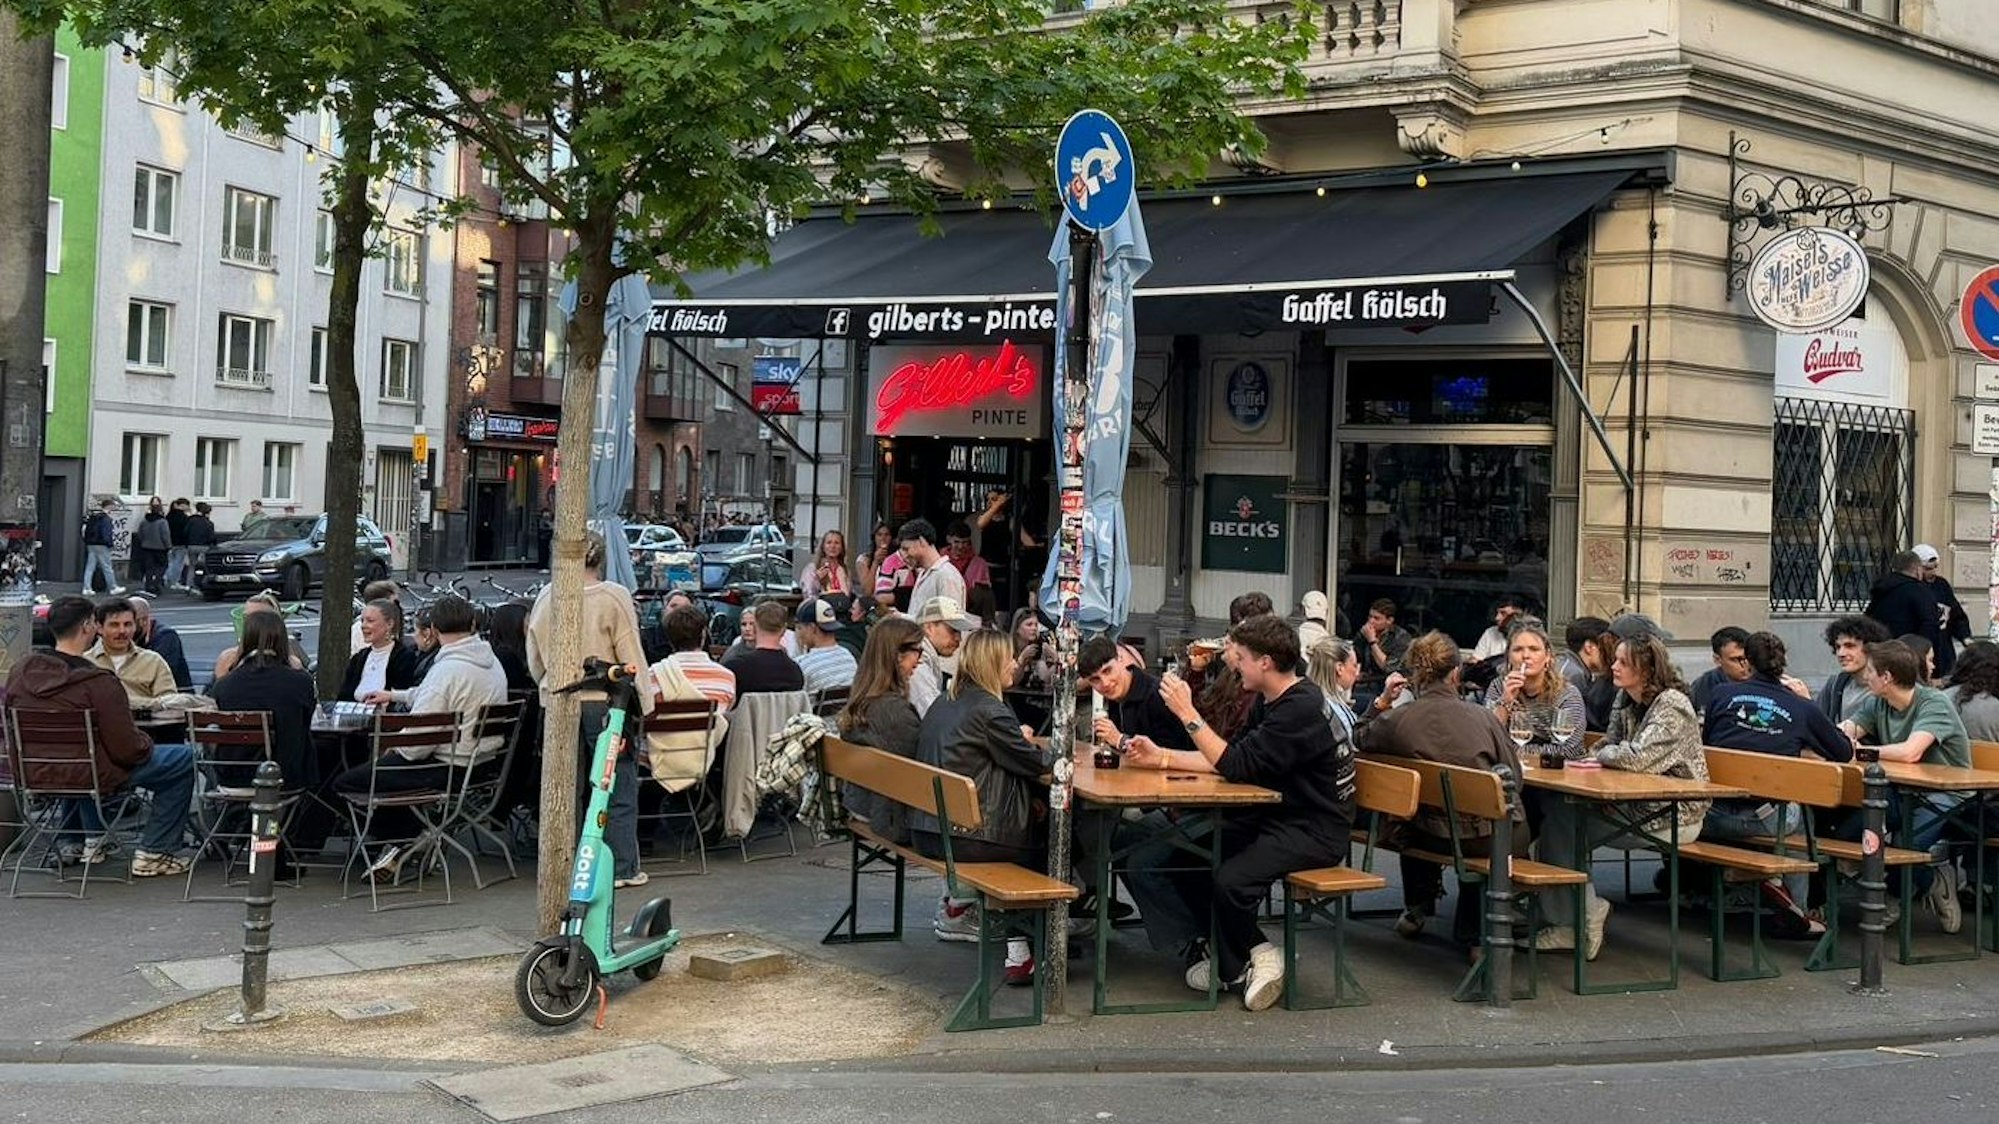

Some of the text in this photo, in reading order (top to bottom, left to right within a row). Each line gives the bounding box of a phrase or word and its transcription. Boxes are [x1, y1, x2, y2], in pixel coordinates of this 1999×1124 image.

[1282, 288, 1447, 325] Gaffel Kölsch
[644, 308, 728, 334] fel Kölsch
[1803, 338, 1864, 374] Budvar
[768, 363, 800, 383] sky
[972, 409, 1027, 425] PINTE
[1209, 520, 1279, 538] BECK'S
[573, 844, 596, 891] dott
